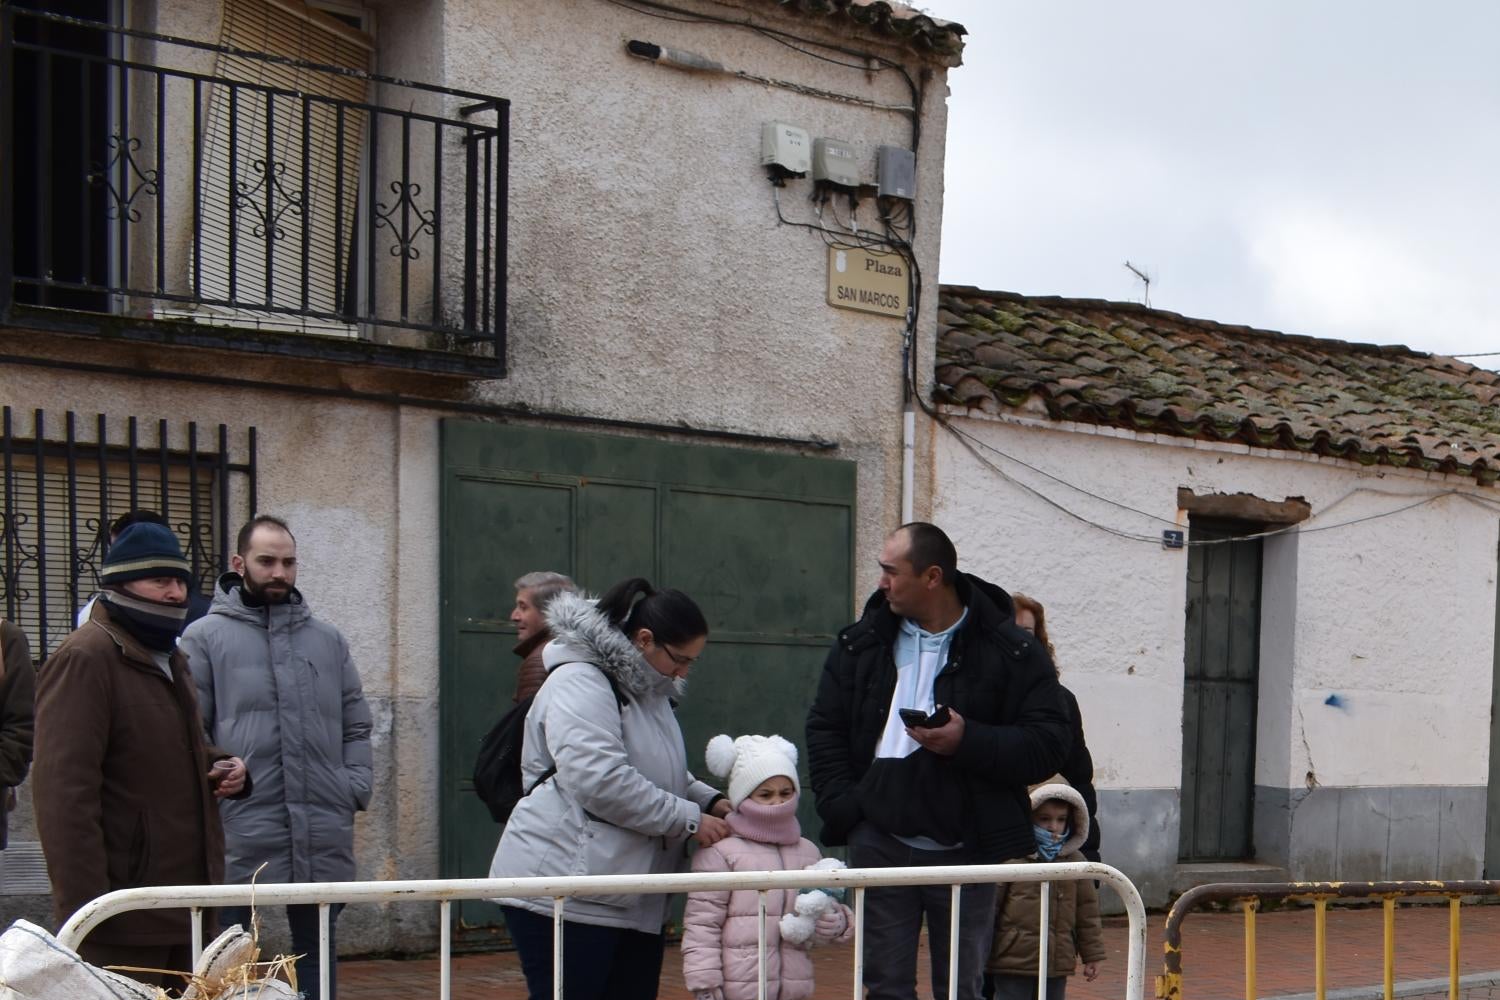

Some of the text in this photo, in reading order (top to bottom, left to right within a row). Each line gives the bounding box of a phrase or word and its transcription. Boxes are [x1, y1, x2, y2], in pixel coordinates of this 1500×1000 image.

[864, 258, 902, 277] Plaza
[837, 285, 900, 309] SAN MARCOS
[1171, 533, 1177, 545] 7
